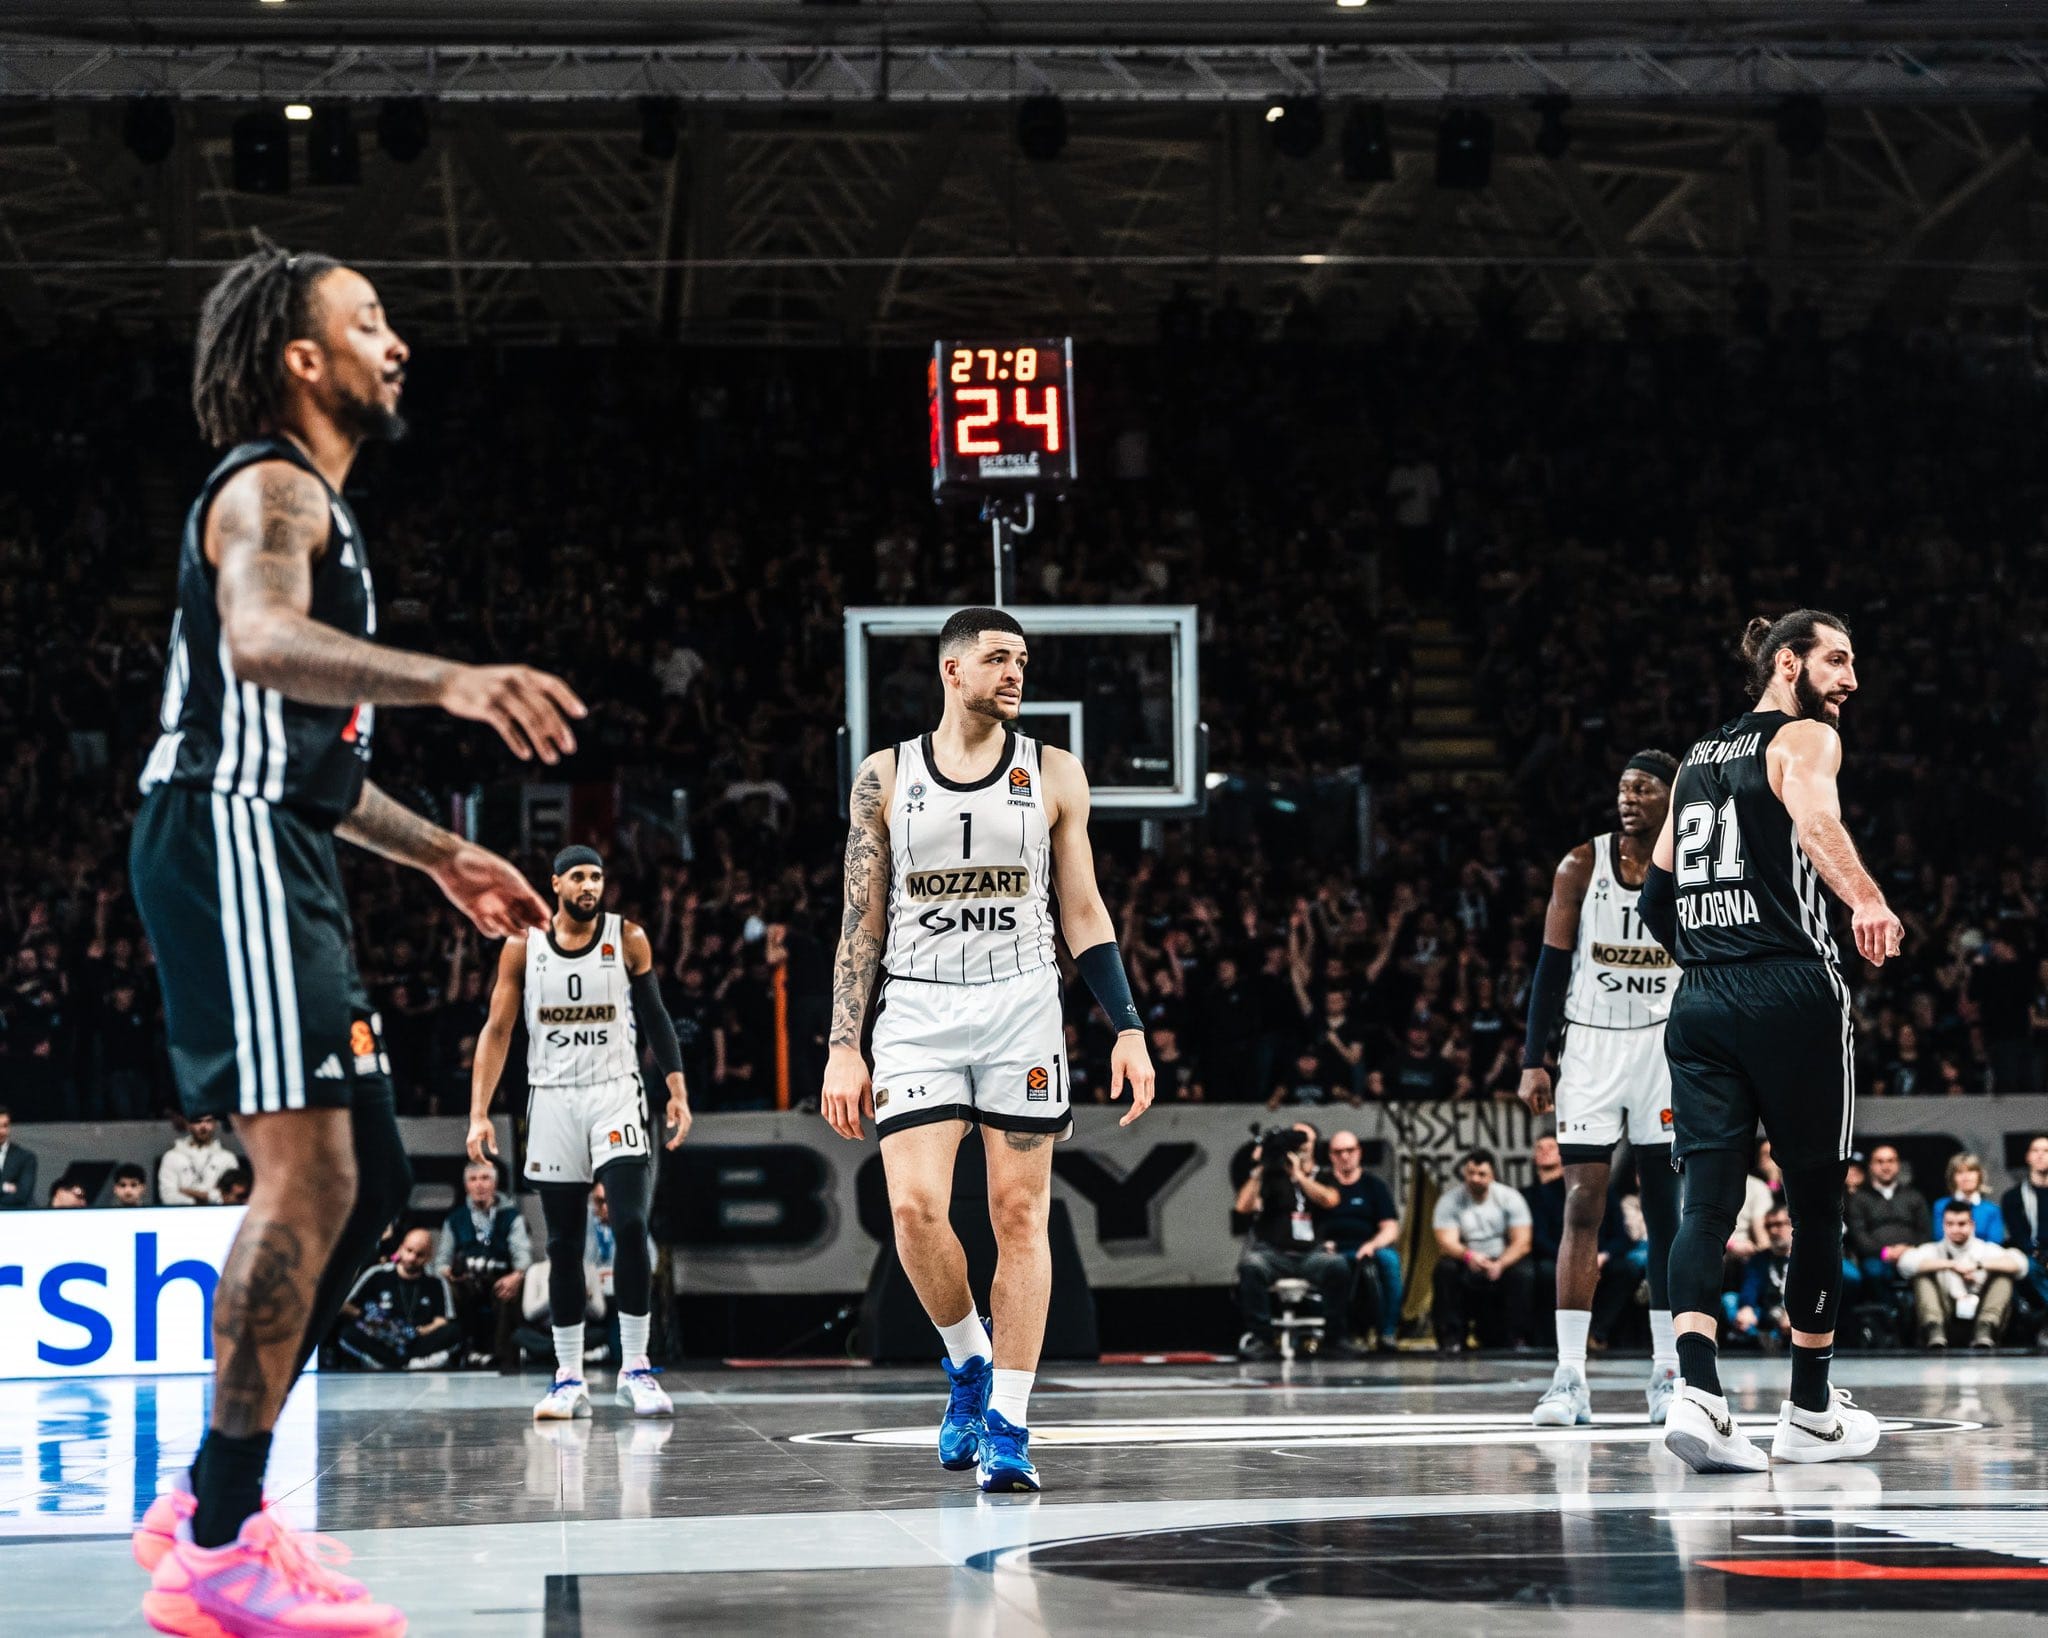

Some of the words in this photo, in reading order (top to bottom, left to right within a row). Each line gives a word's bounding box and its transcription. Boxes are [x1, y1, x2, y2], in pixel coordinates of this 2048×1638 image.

[951, 348, 1037, 382] 27:8
[955, 387, 1059, 453] 24
[959, 813, 972, 859] 1
[1676, 796, 1744, 888] 21
[910, 871, 1026, 898] MOZZART
[961, 907, 1016, 931] NIS
[567, 973, 582, 1001] 0
[1627, 976, 1667, 994] NIS
[539, 1005, 616, 1023] MOZZART
[573, 1030, 608, 1046] NIS
[1053, 1054, 1062, 1103] 1
[624, 1123, 637, 1148] 0
